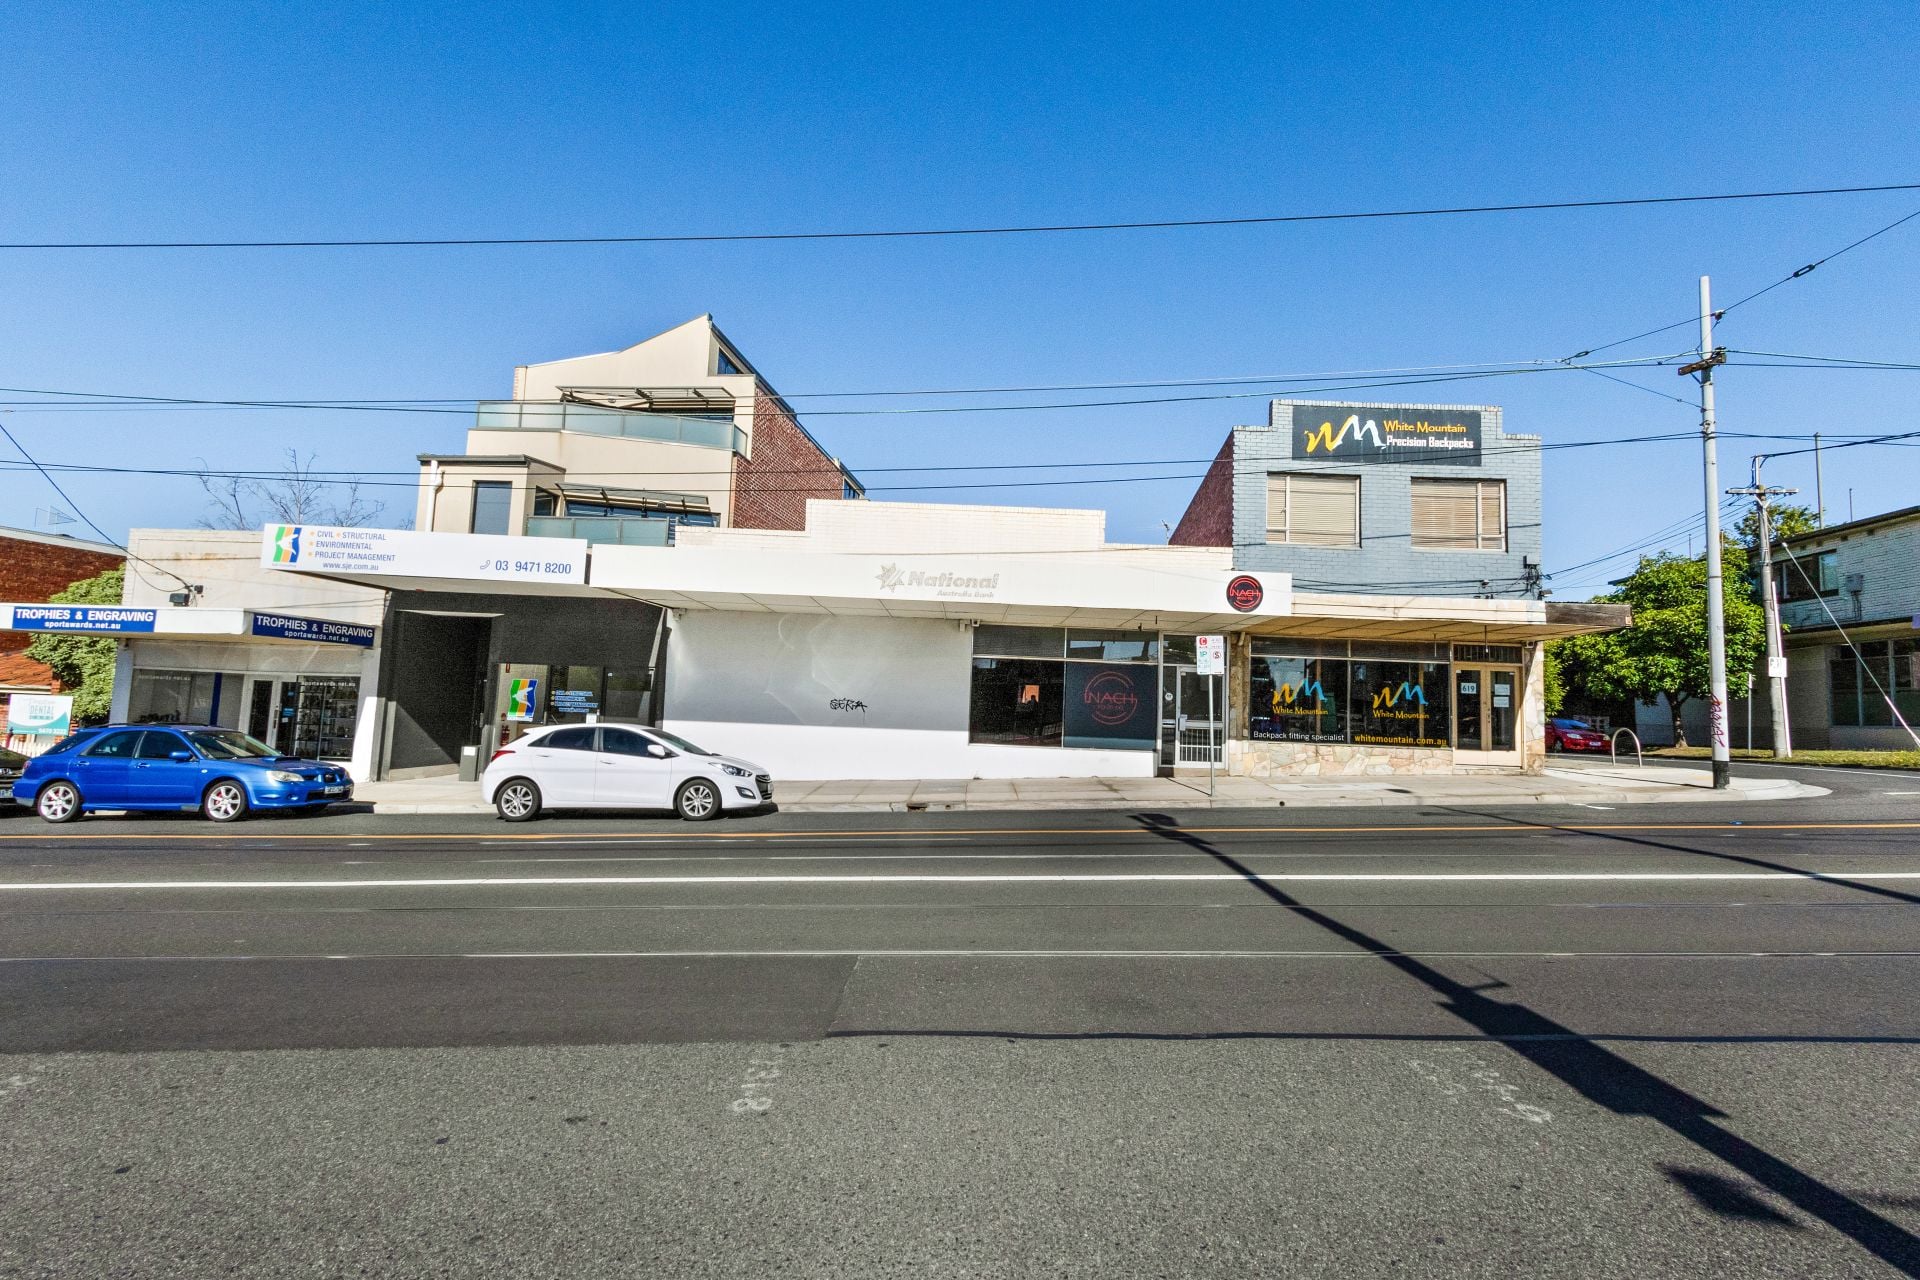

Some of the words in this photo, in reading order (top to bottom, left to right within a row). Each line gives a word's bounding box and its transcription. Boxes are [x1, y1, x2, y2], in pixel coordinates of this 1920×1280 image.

[1384, 420, 1415, 432] White
[1417, 422, 1467, 433] Mountain
[1386, 435, 1427, 447] Precision
[1429, 437, 1474, 449] Backpacks
[317, 530, 334, 539] CIVIL
[342, 531, 387, 541] STRUCTURAL
[315, 540, 373, 551] ENVIRONMENTAL
[315, 551, 345, 560] PROJECT
[346, 552, 396, 562] MANAGEMENT
[322, 562, 379, 571] www.sje.com.au
[495, 560, 509, 571] 03
[515, 561, 541, 573] 9471
[544, 562, 572, 574] 8200
[907, 571, 1000, 589] National
[15, 608, 71, 620] TROPHIES
[75, 611, 83, 620] &
[88, 610, 155, 622] ENGRAVING
[44, 620, 122, 630] sportawards.net.au
[256, 615, 308, 631] TROPHIES
[311, 623, 318, 632] &
[322, 623, 374, 638] ENGRAVING
[284, 630, 349, 642] sportawards.net.au
[1462, 685, 1475, 693] 619
[1272, 705, 1294, 715] White
[1295, 706, 1328, 716] Mountain
[1372, 709, 1395, 719] White
[1395, 710, 1430, 720] Mountain
[1253, 731, 1287, 740] Backpack
[1289, 732, 1310, 741] fitting
[1311, 734, 1345, 742] specialist
[1354, 734, 1447, 746] whitemountain.com.au
